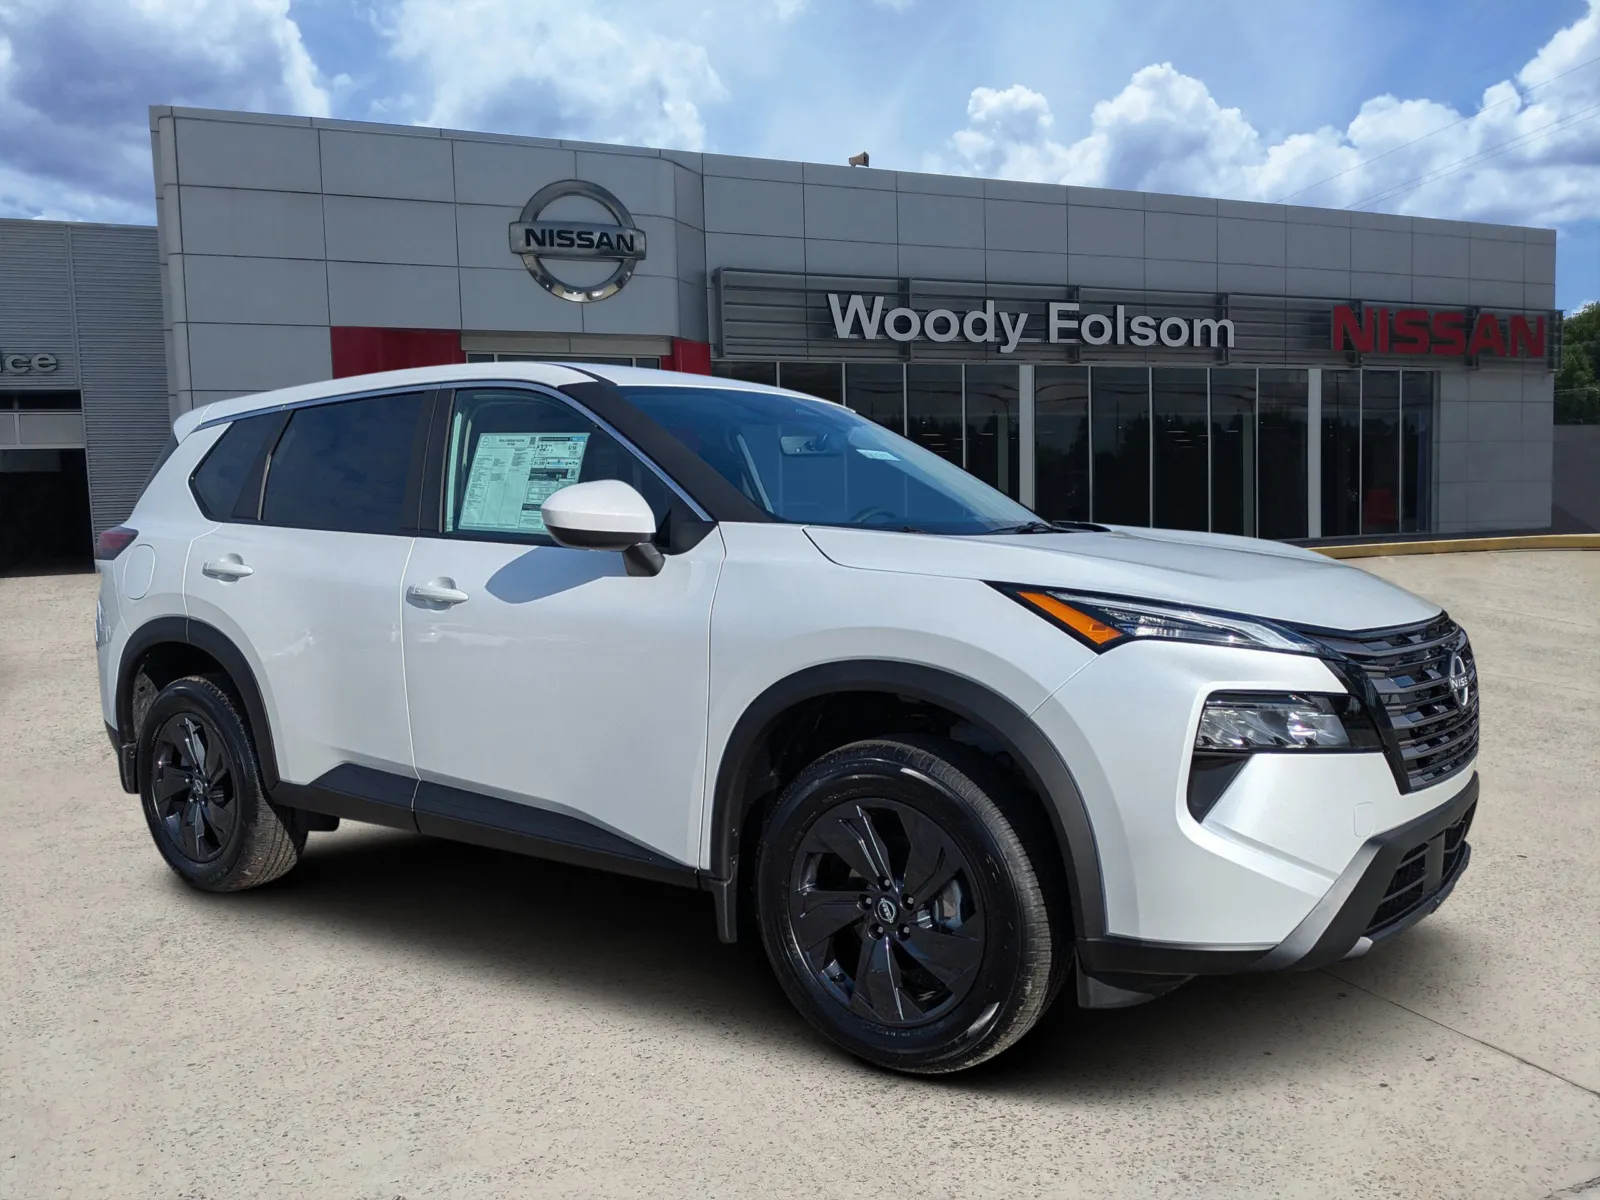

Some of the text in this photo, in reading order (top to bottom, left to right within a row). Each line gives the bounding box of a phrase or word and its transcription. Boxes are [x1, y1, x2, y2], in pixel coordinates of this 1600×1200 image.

[524, 228, 635, 253] NISSAN
[827, 293, 1545, 358] Woody Folsom NISSAN
[0, 353, 58, 374] ce
